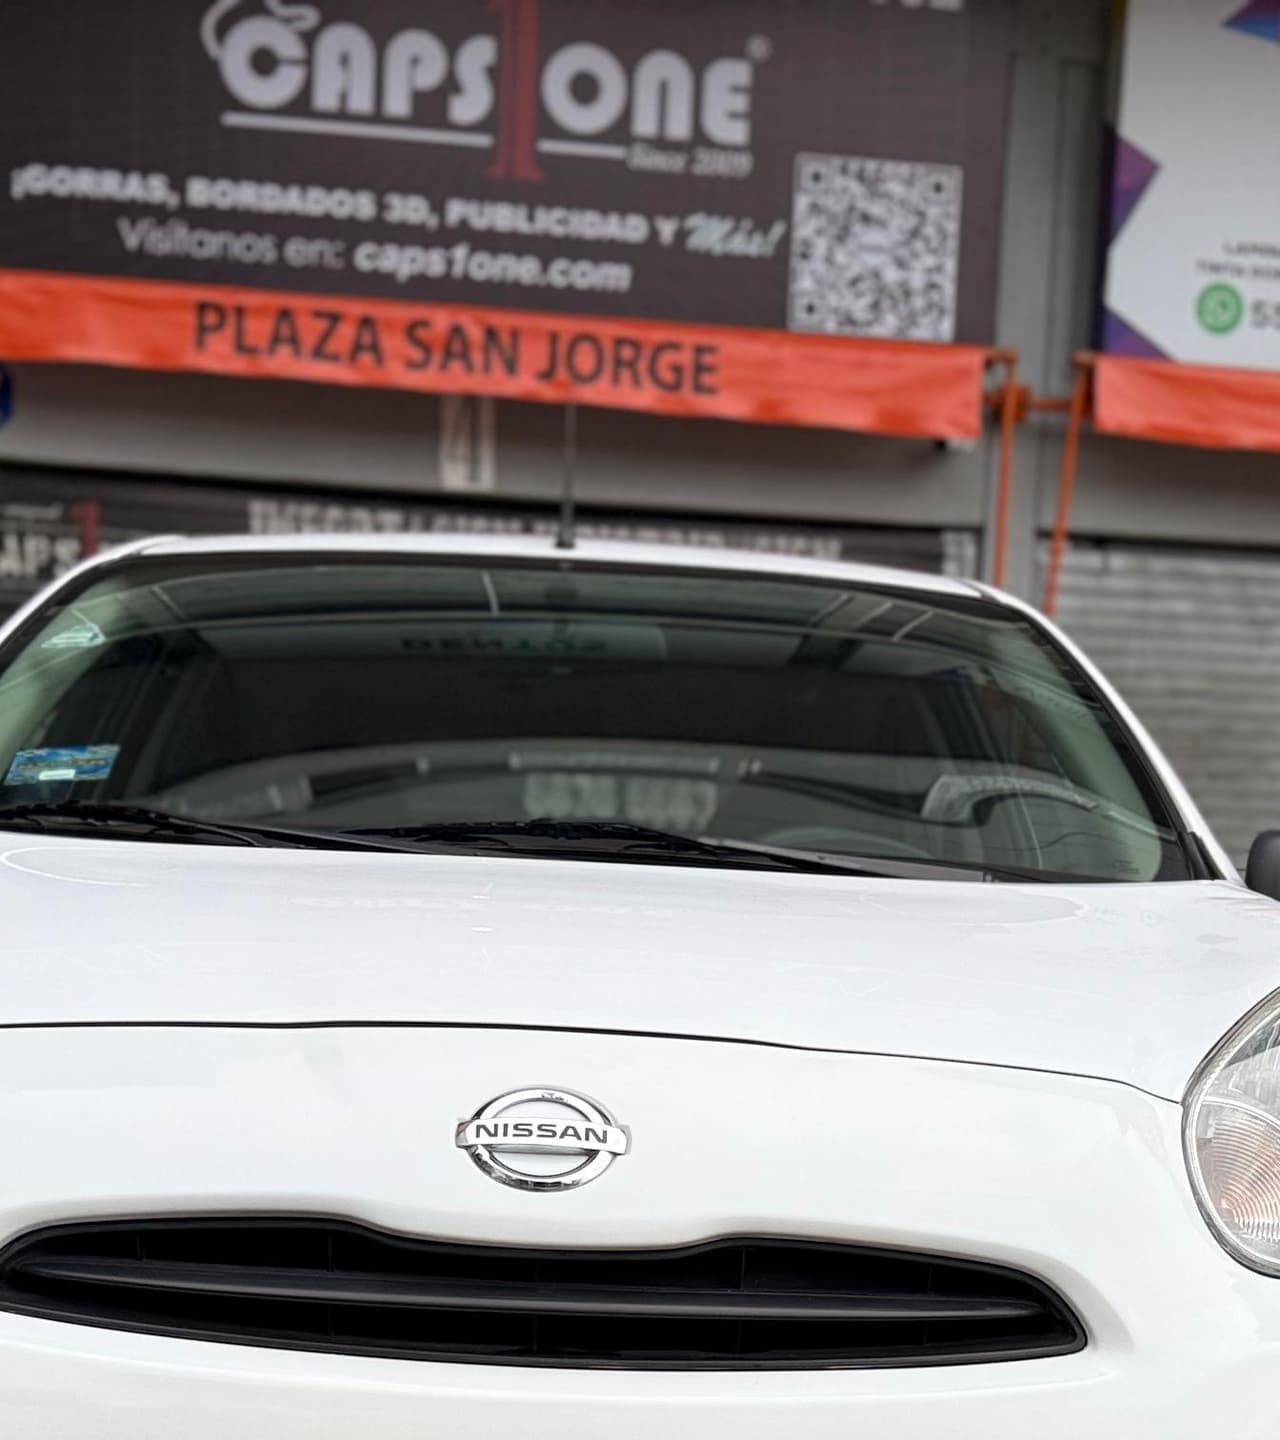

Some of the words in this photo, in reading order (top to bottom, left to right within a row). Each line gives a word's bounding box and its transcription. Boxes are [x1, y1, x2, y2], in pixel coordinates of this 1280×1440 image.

[186, 175, 378, 222] BORDADOS
[383, 191, 439, 233] 3D,
[445, 197, 650, 246] PUBLICIDAD
[654, 222, 679, 247] Y
[282, 234, 346, 271] en:
[193, 298, 384, 369] PLAZA
[404, 318, 519, 376] SAN
[537, 332, 720, 397] JORGE
[475, 1122, 608, 1145] NISSAN
